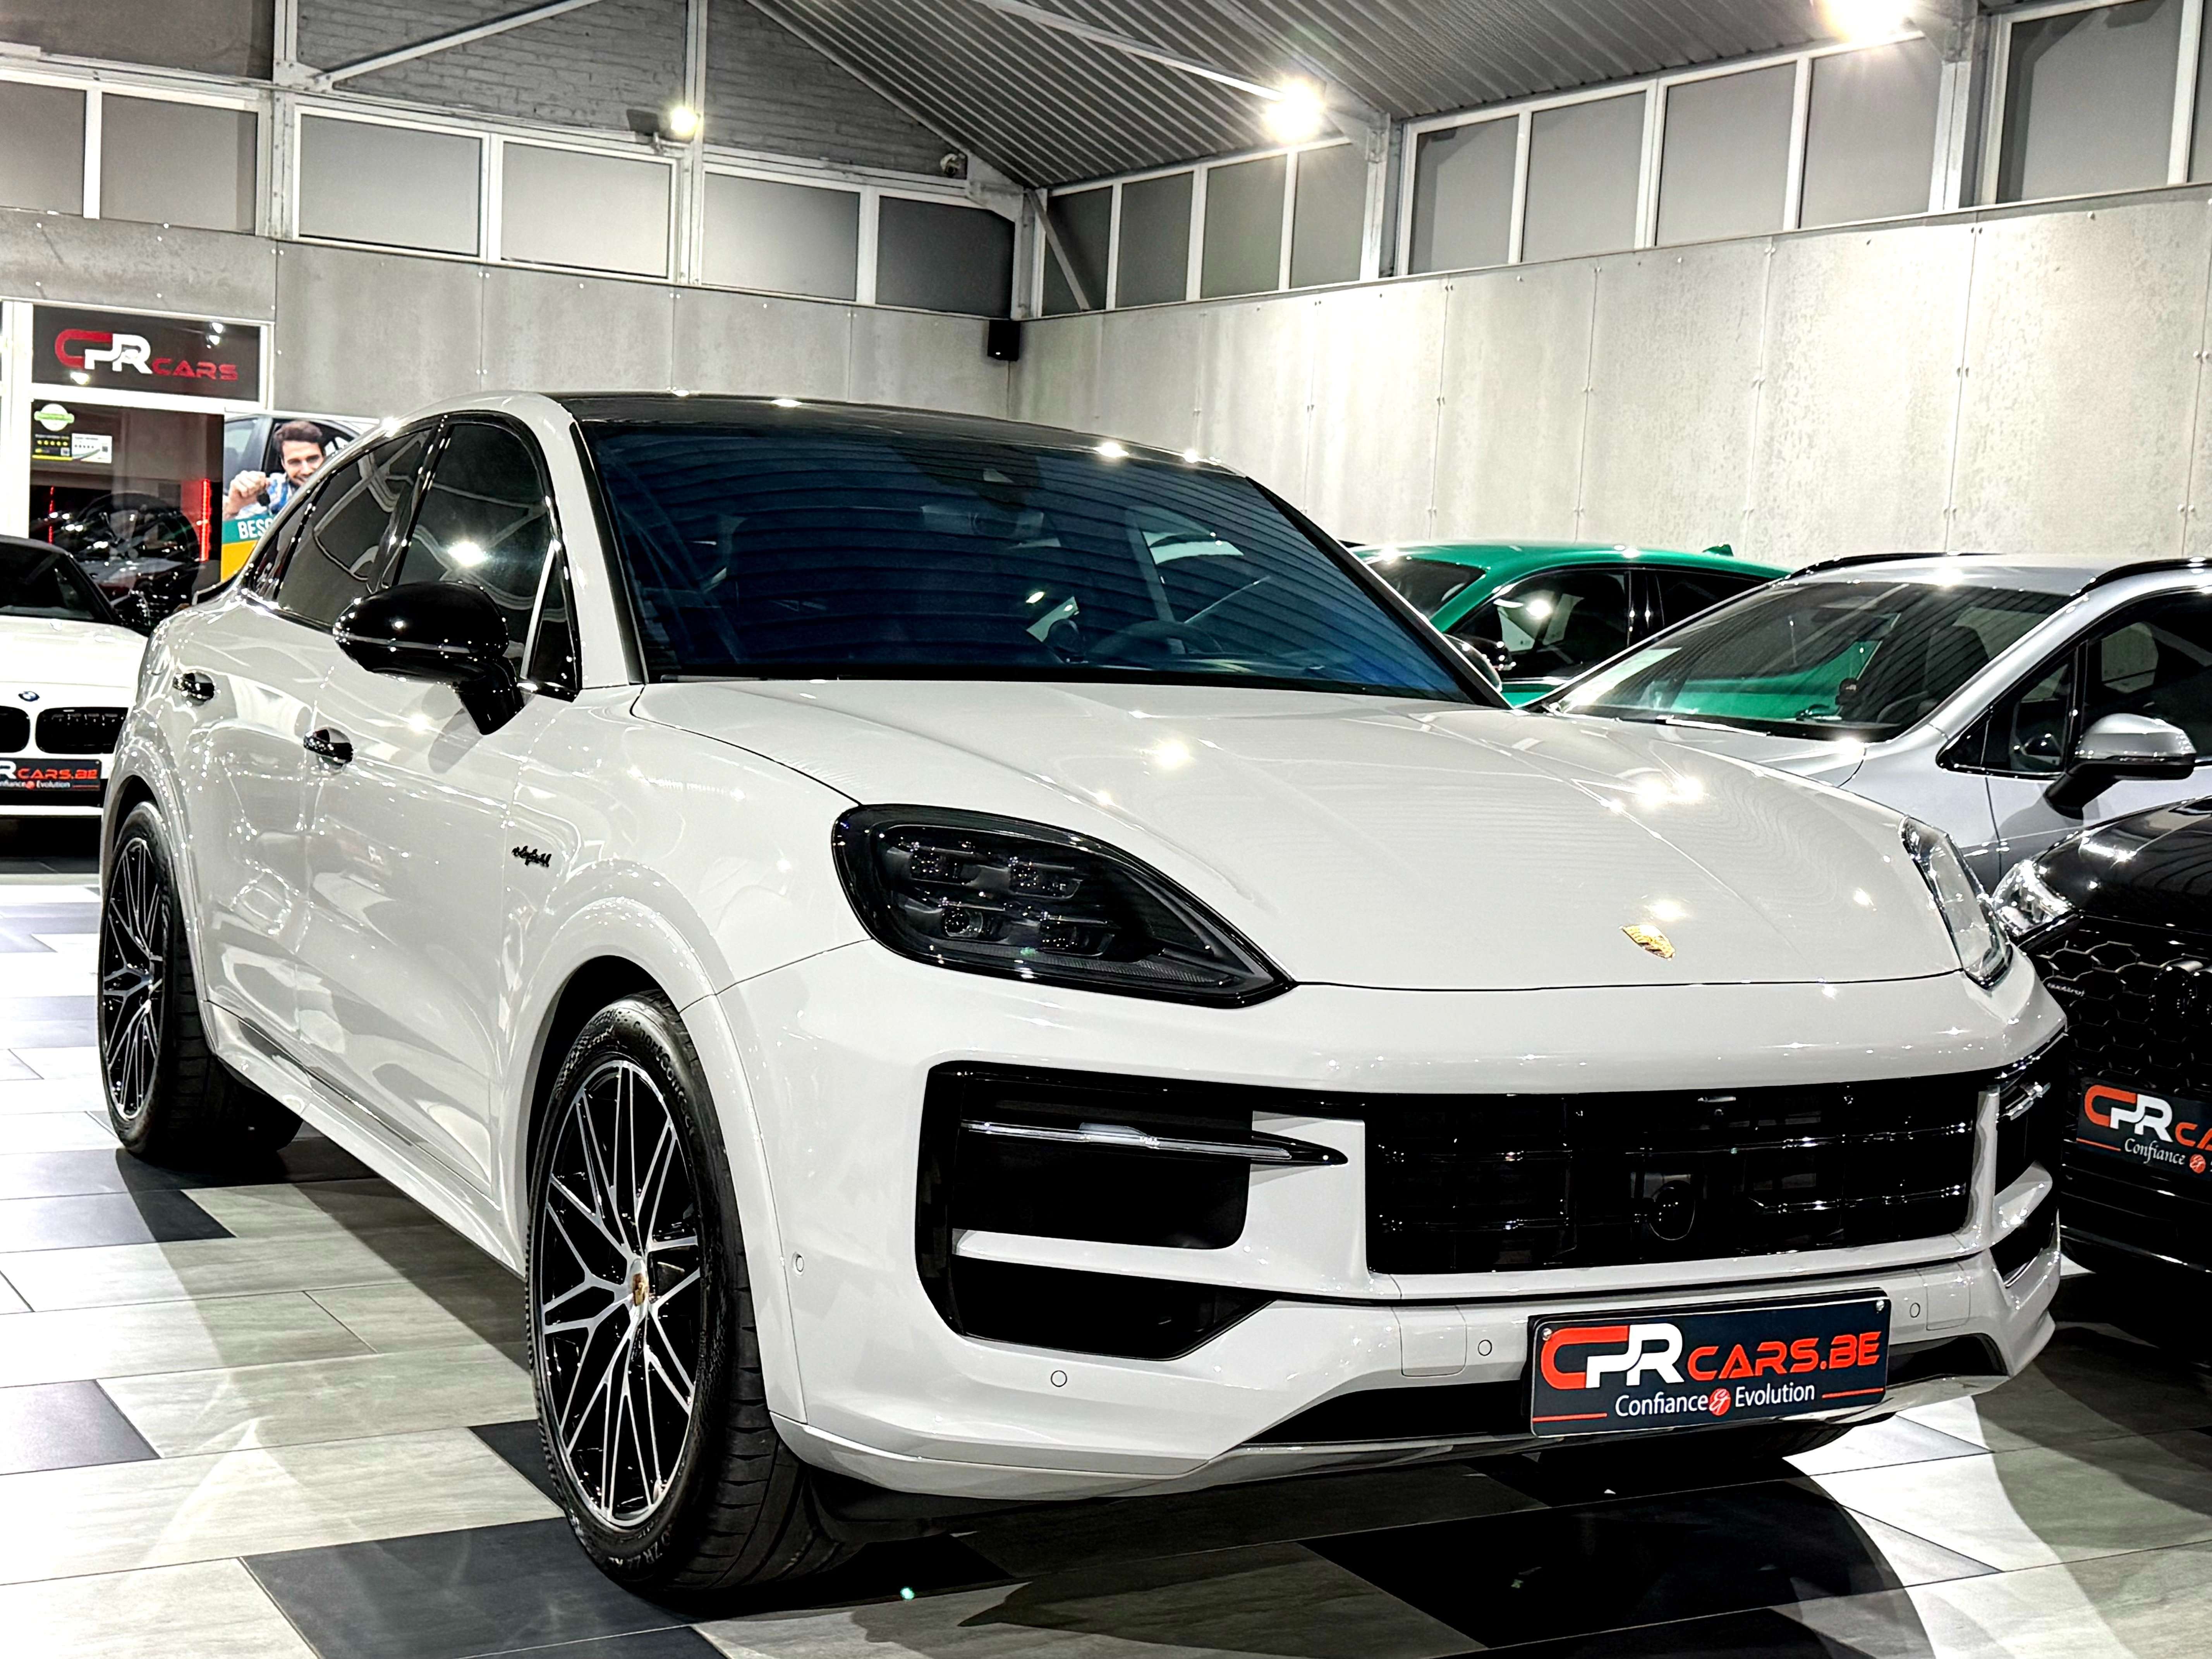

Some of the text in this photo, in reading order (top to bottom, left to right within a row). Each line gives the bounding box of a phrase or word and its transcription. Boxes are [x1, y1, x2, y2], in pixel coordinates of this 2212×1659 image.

[55, 328, 238, 380] CPR CARS
[17, 768, 98, 780] CARS.BE
[2084, 1085, 2173, 1142] CPR
[2124, 1138, 2186, 1165] Confiance
[1540, 1322, 1882, 1390] CPR CARS.BE
[1615, 1391, 1709, 1417] Confiance
[1735, 1382, 1815, 1407] Evolution
